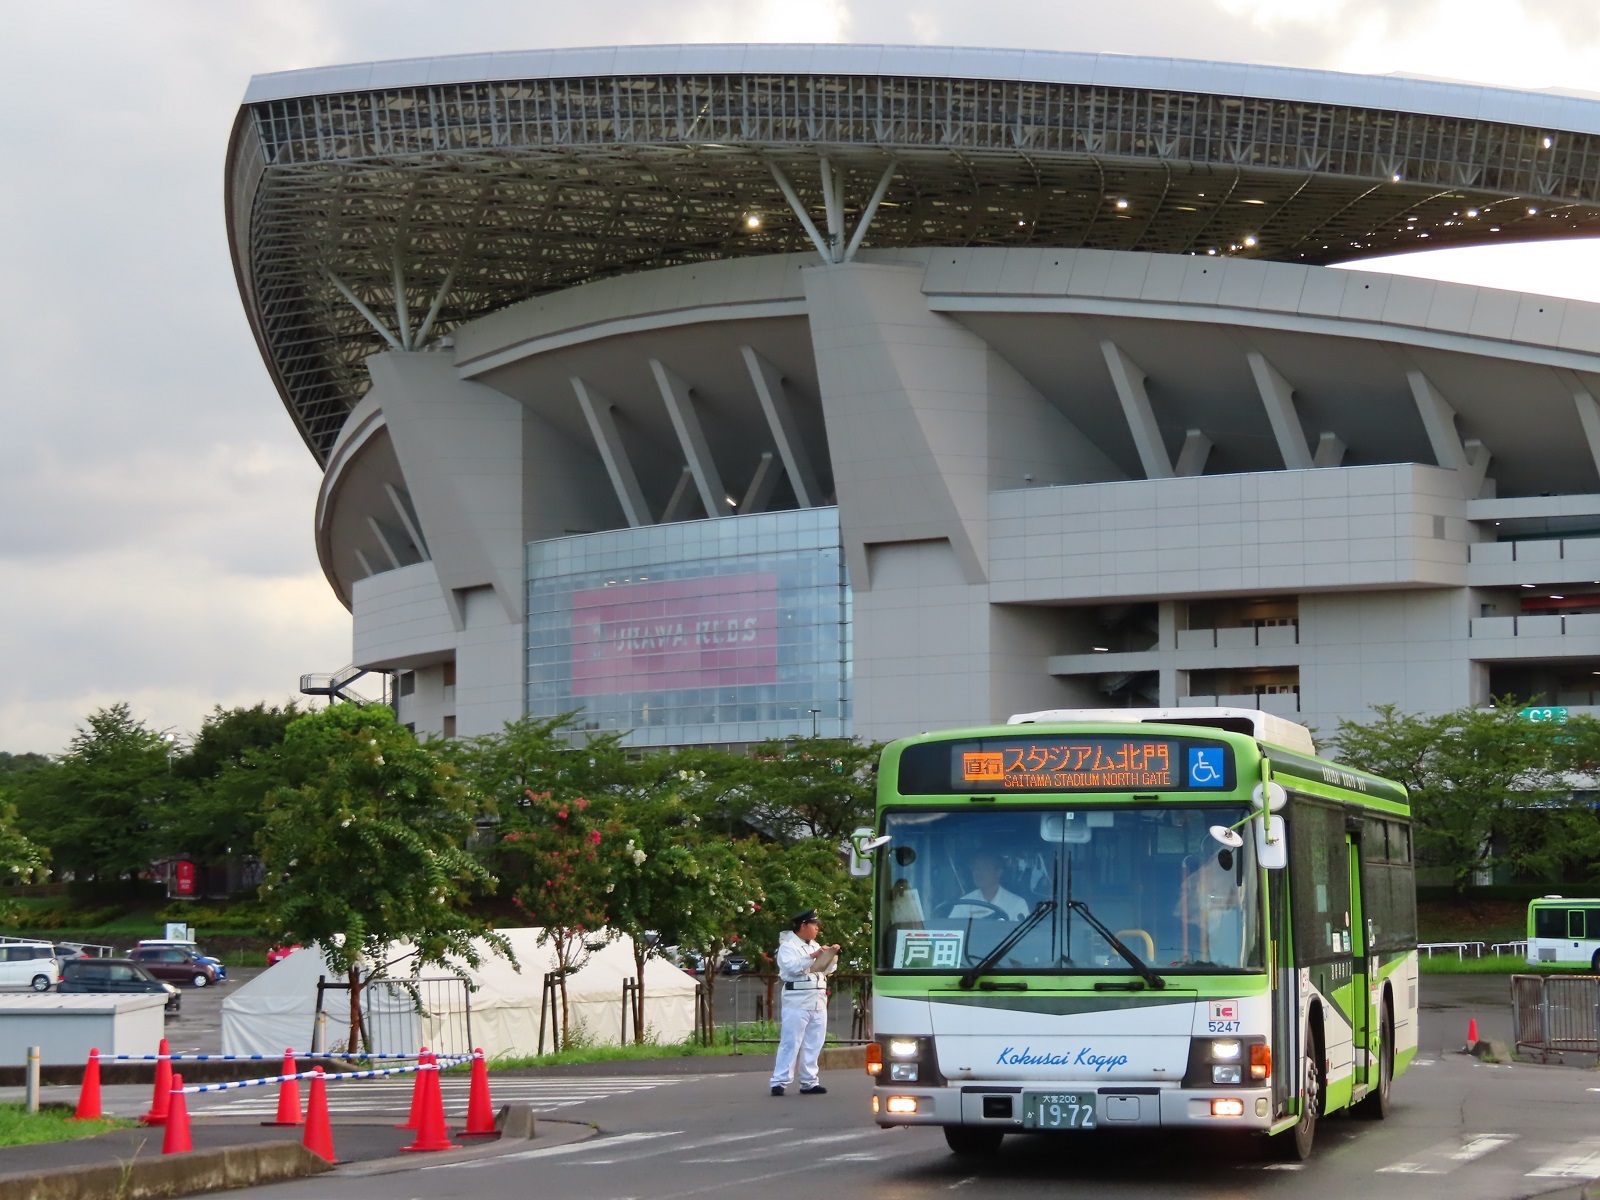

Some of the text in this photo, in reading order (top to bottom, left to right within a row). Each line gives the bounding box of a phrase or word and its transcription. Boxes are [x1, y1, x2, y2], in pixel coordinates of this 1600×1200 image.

[1530, 709, 1552, 723] C3
[965, 758, 1001, 775] 直行
[1005, 744, 1168, 771] スタジアム北門
[1004, 771, 1170, 788] SAITAMA STADIUM NORTH GATE
[905, 941, 957, 966] 戸田
[1208, 1021, 1240, 1032] 5247
[996, 1047, 1128, 1072] Kokusai Kogyo
[1039, 1104, 1093, 1127] 19-72
